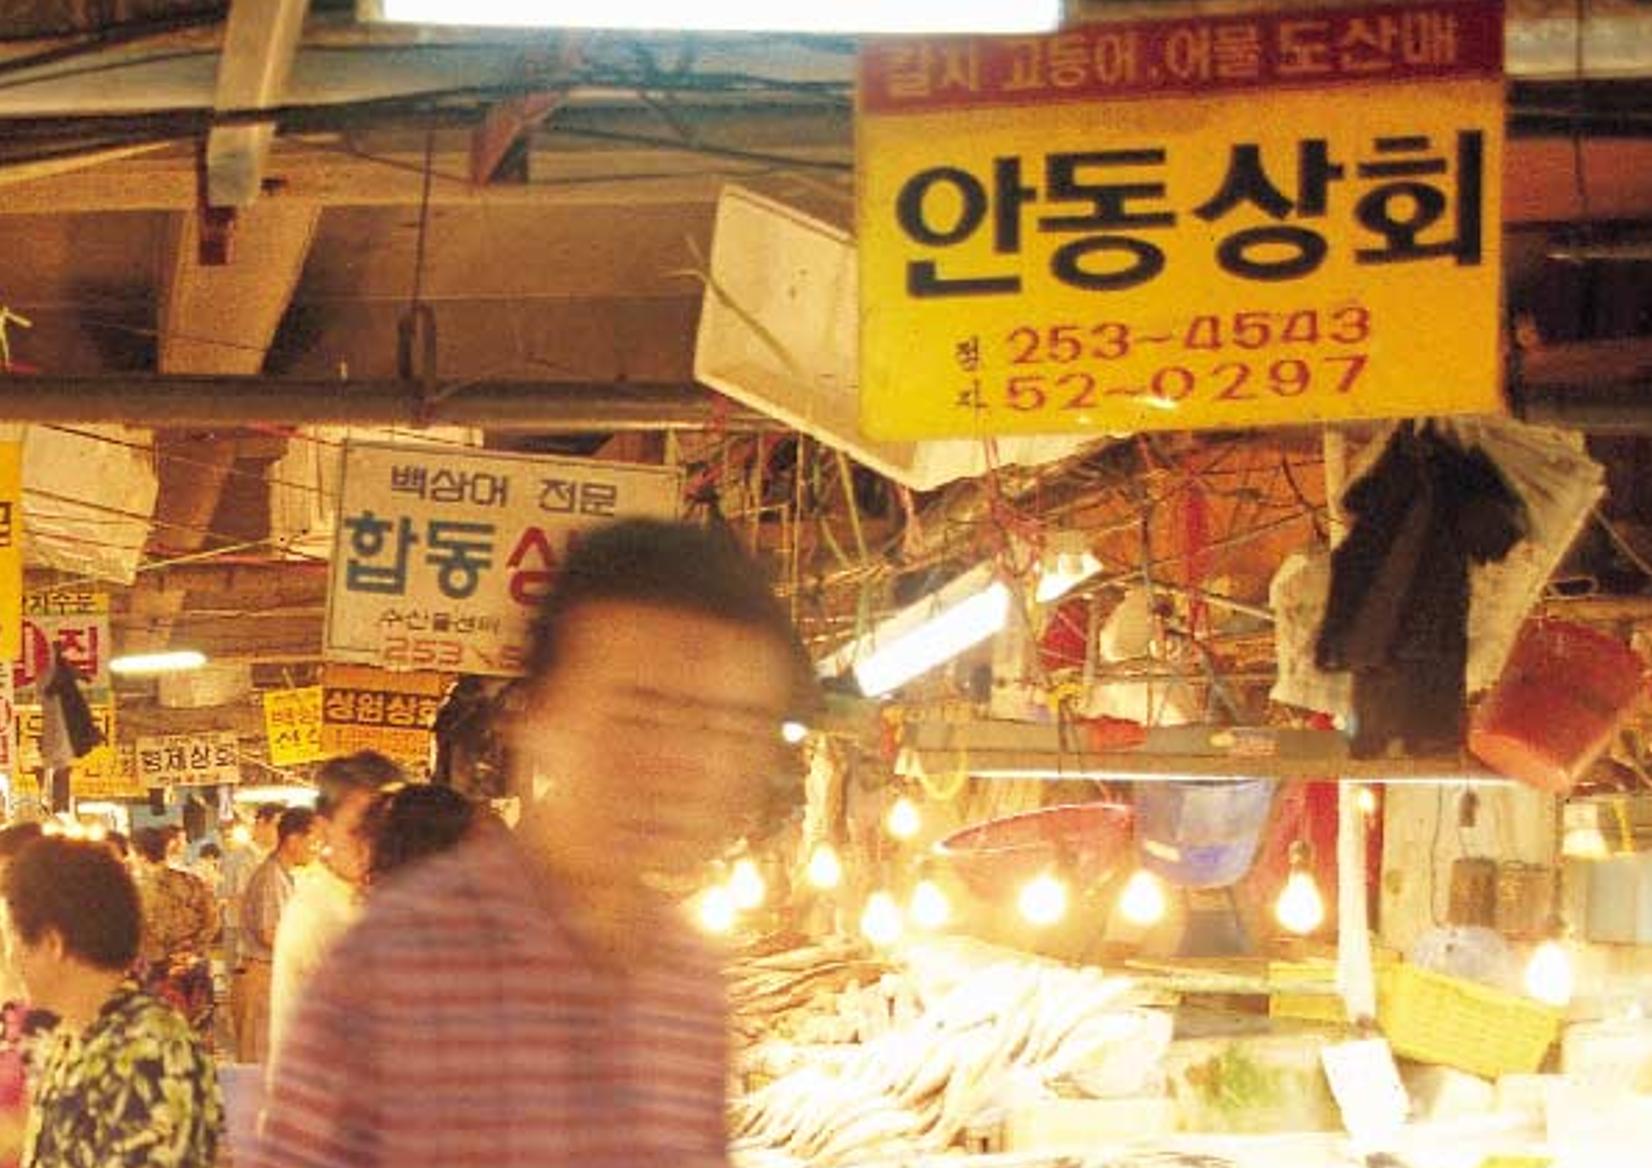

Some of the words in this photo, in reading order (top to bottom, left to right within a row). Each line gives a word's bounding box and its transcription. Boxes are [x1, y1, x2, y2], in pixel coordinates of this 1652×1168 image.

[1278, 10, 1457, 73] 도산매
[896, 130, 1484, 299] 안동상회
[538, 478, 617, 517] 전문
[344, 510, 586, 607] 합동상
